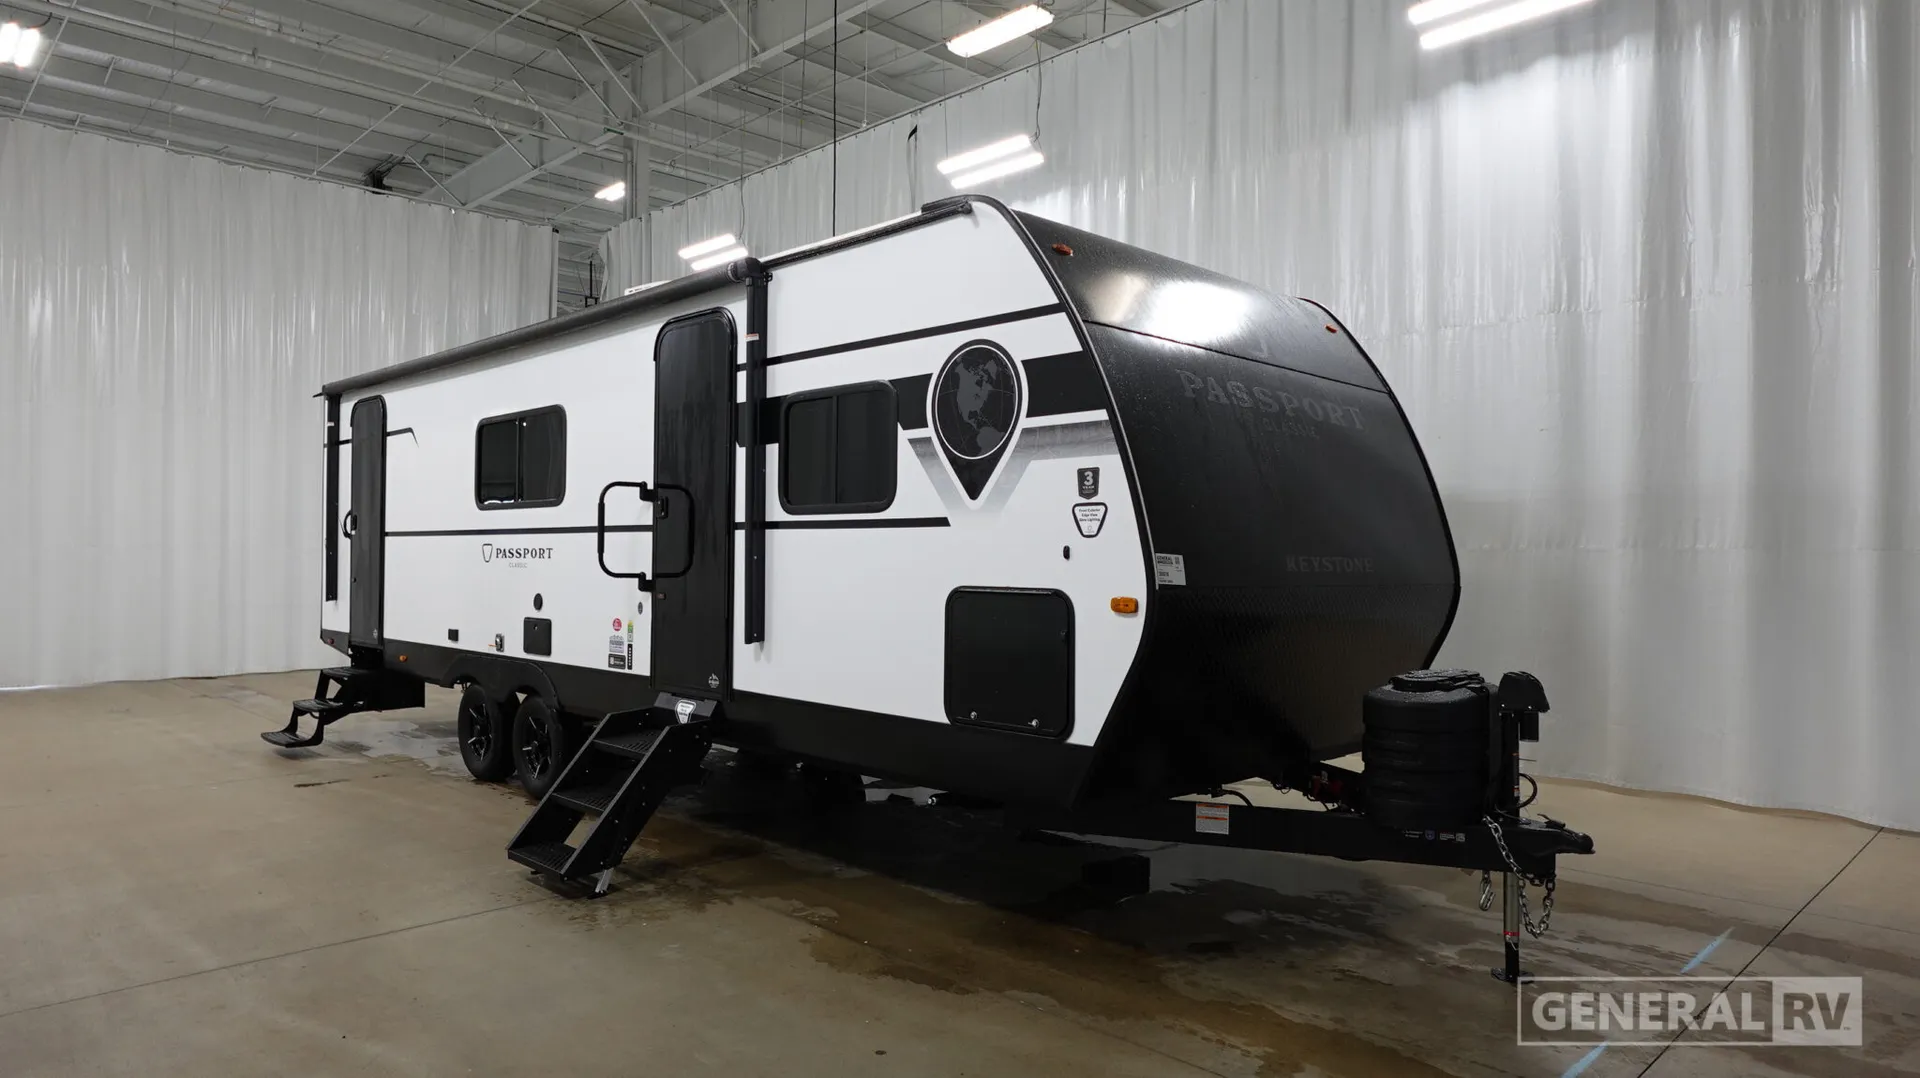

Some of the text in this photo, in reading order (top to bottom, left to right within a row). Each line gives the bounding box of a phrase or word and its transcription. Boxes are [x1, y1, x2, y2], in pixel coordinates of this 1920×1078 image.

[1175, 369, 1365, 431] PASSPORT
[1083, 471, 1094, 486] 3
[495, 547, 554, 559] PASSPORT
[1285, 554, 1375, 574] KEYSTONE
